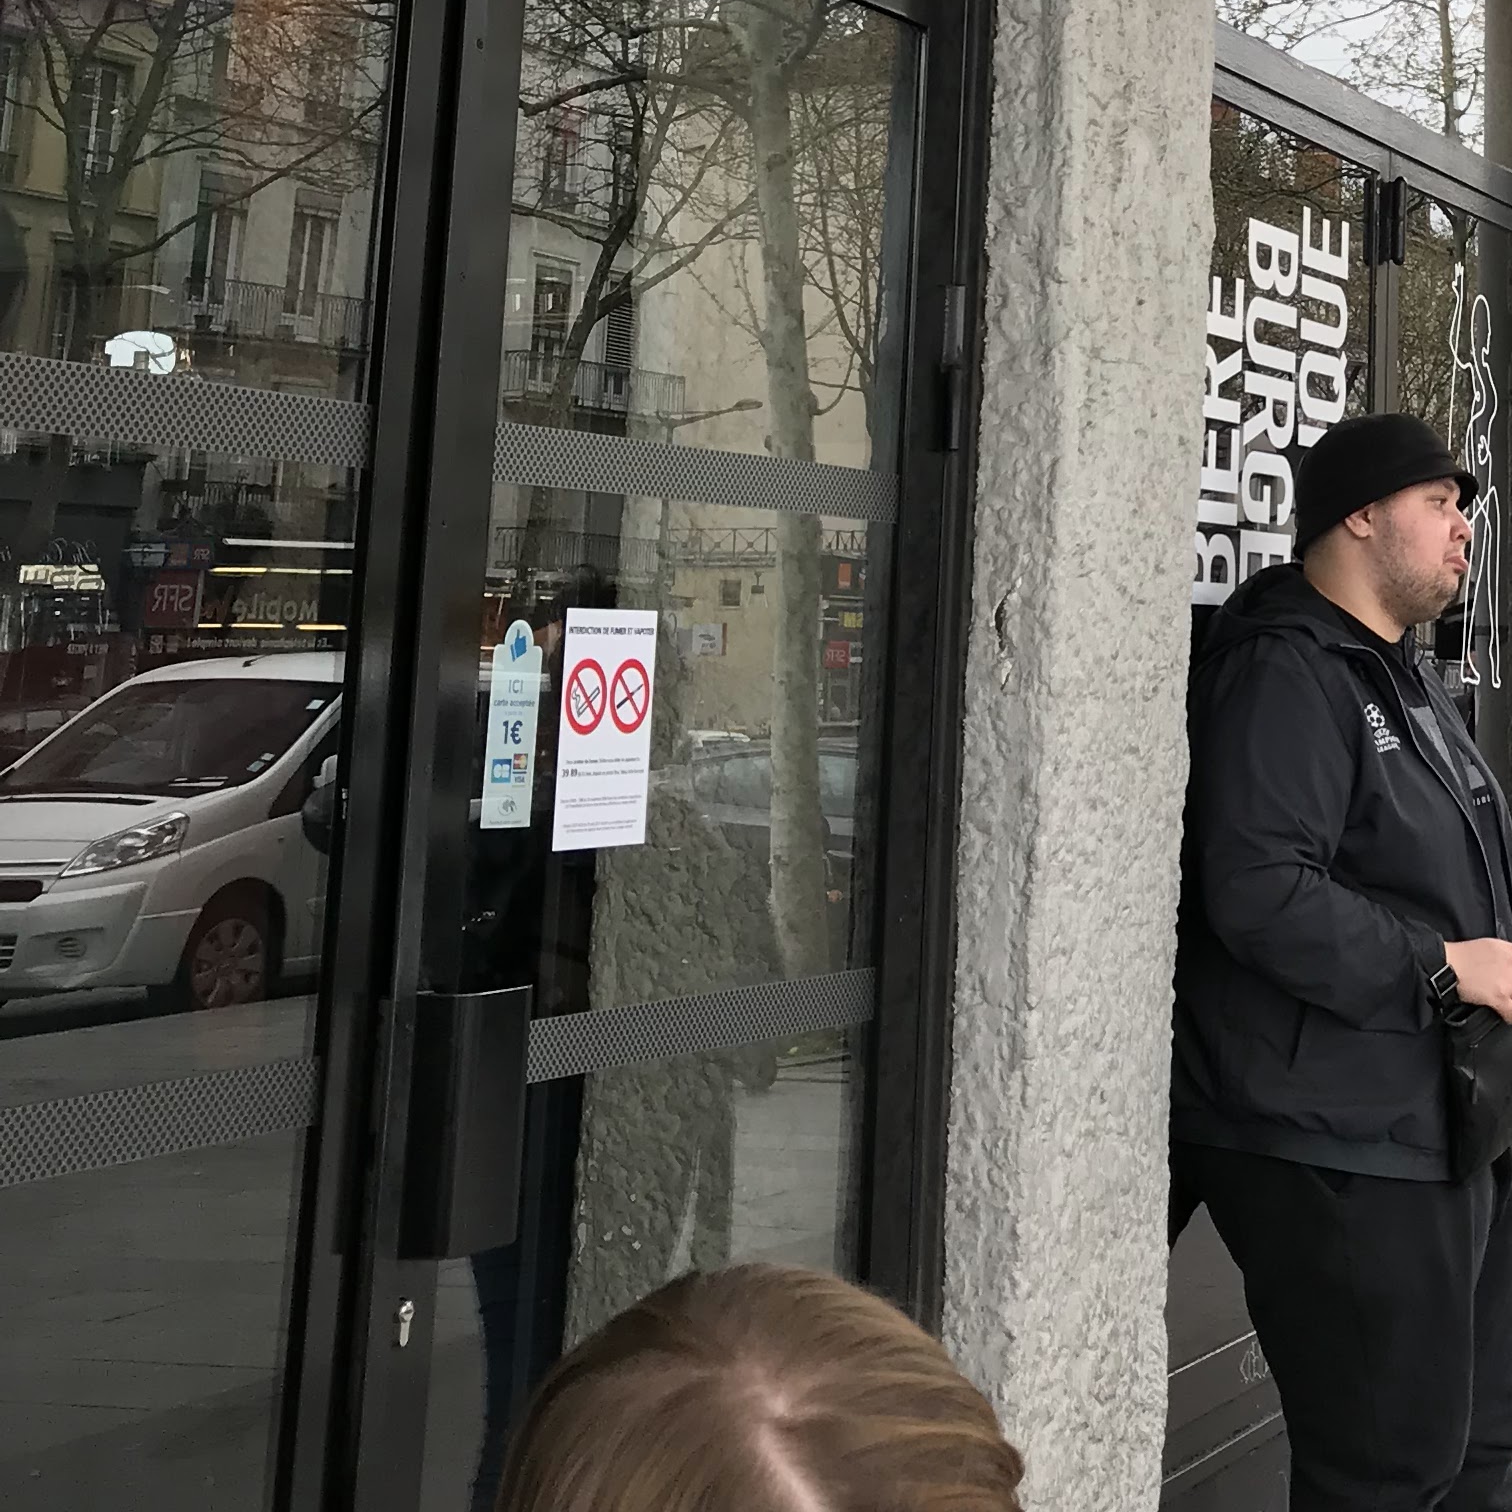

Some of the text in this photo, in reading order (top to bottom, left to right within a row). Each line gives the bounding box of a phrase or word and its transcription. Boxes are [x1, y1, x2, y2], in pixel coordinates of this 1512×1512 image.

[1298, 206, 1350, 448] IQUE
[1240, 217, 1299, 579] BURGE
[508, 679, 524, 694] ICI
[493, 699, 508, 707] carte
[502, 720, 524, 744] 1€
